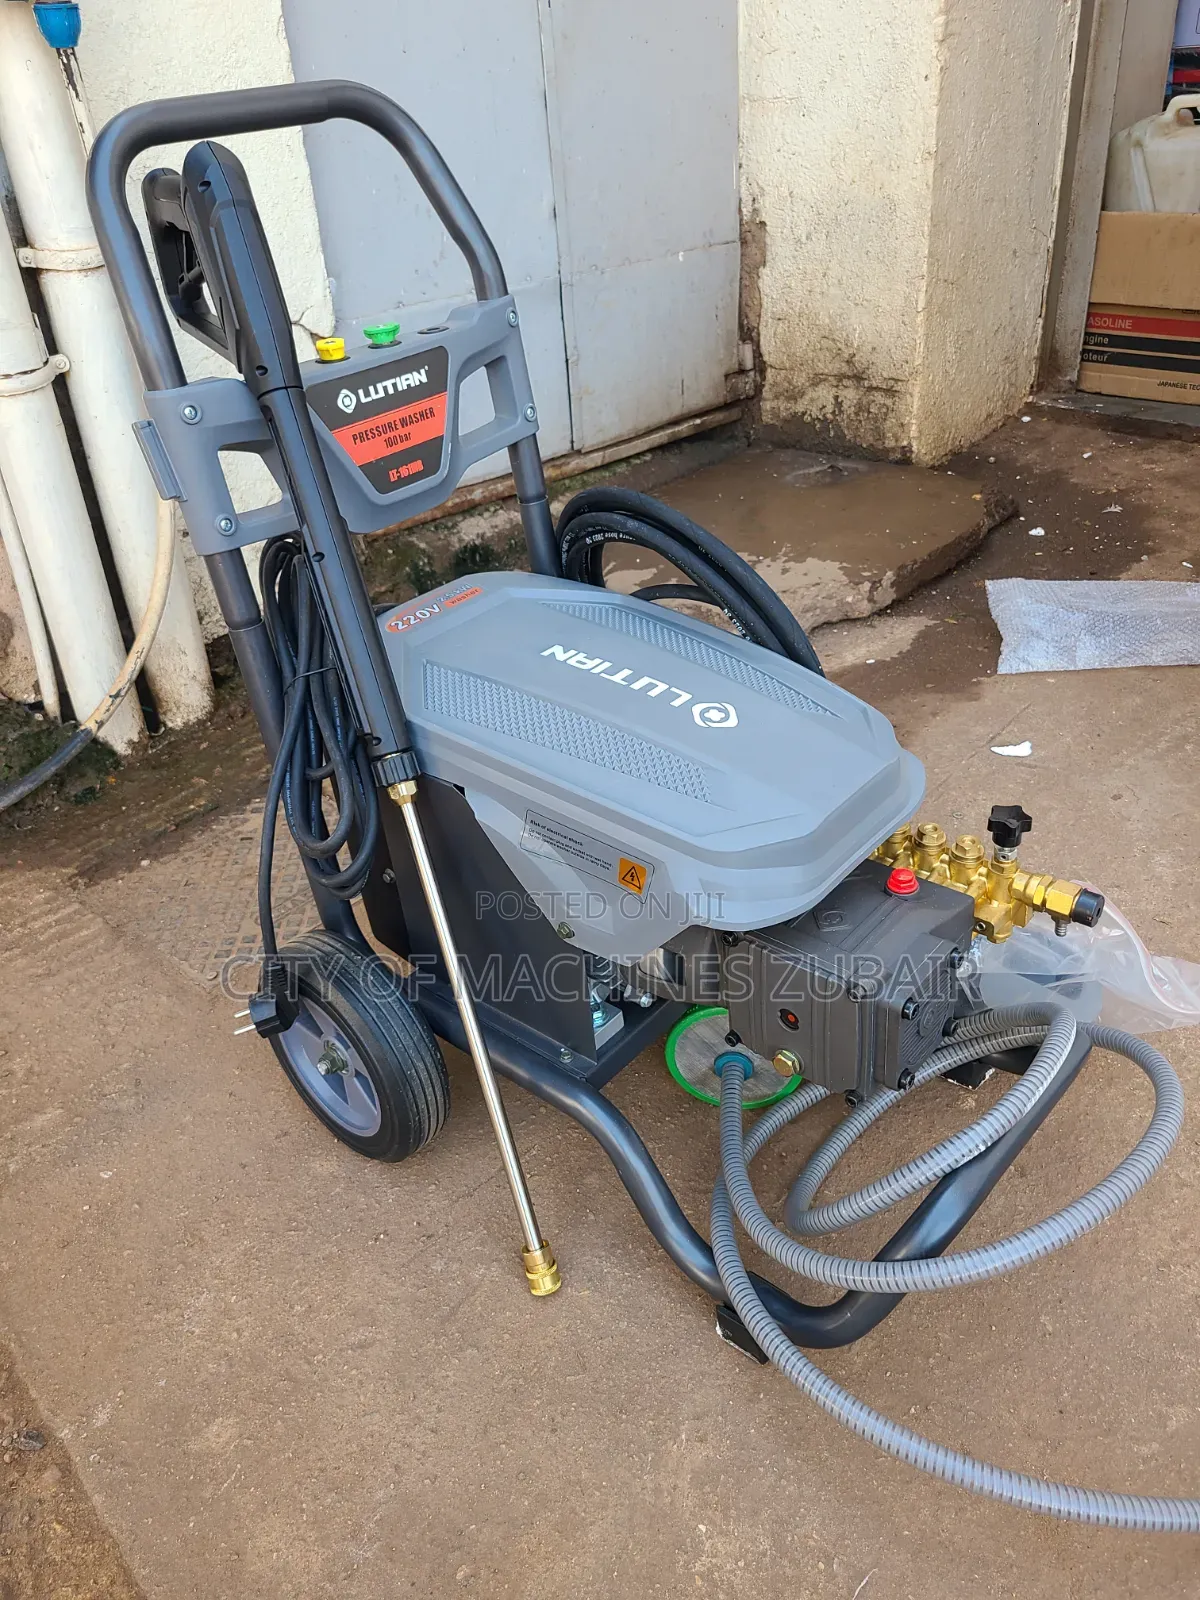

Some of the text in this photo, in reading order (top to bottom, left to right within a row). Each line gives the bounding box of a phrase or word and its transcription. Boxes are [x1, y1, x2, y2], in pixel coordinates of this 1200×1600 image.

[357, 368, 428, 403] LUTIAN
[1157, 381, 1188, 390] JAPANESE
[351, 406, 436, 446] PRESSURE WASHER
[384, 432, 411, 449] 100 bar
[390, 602, 441, 631] 220V
[540, 643, 693, 708] LUTIAN
